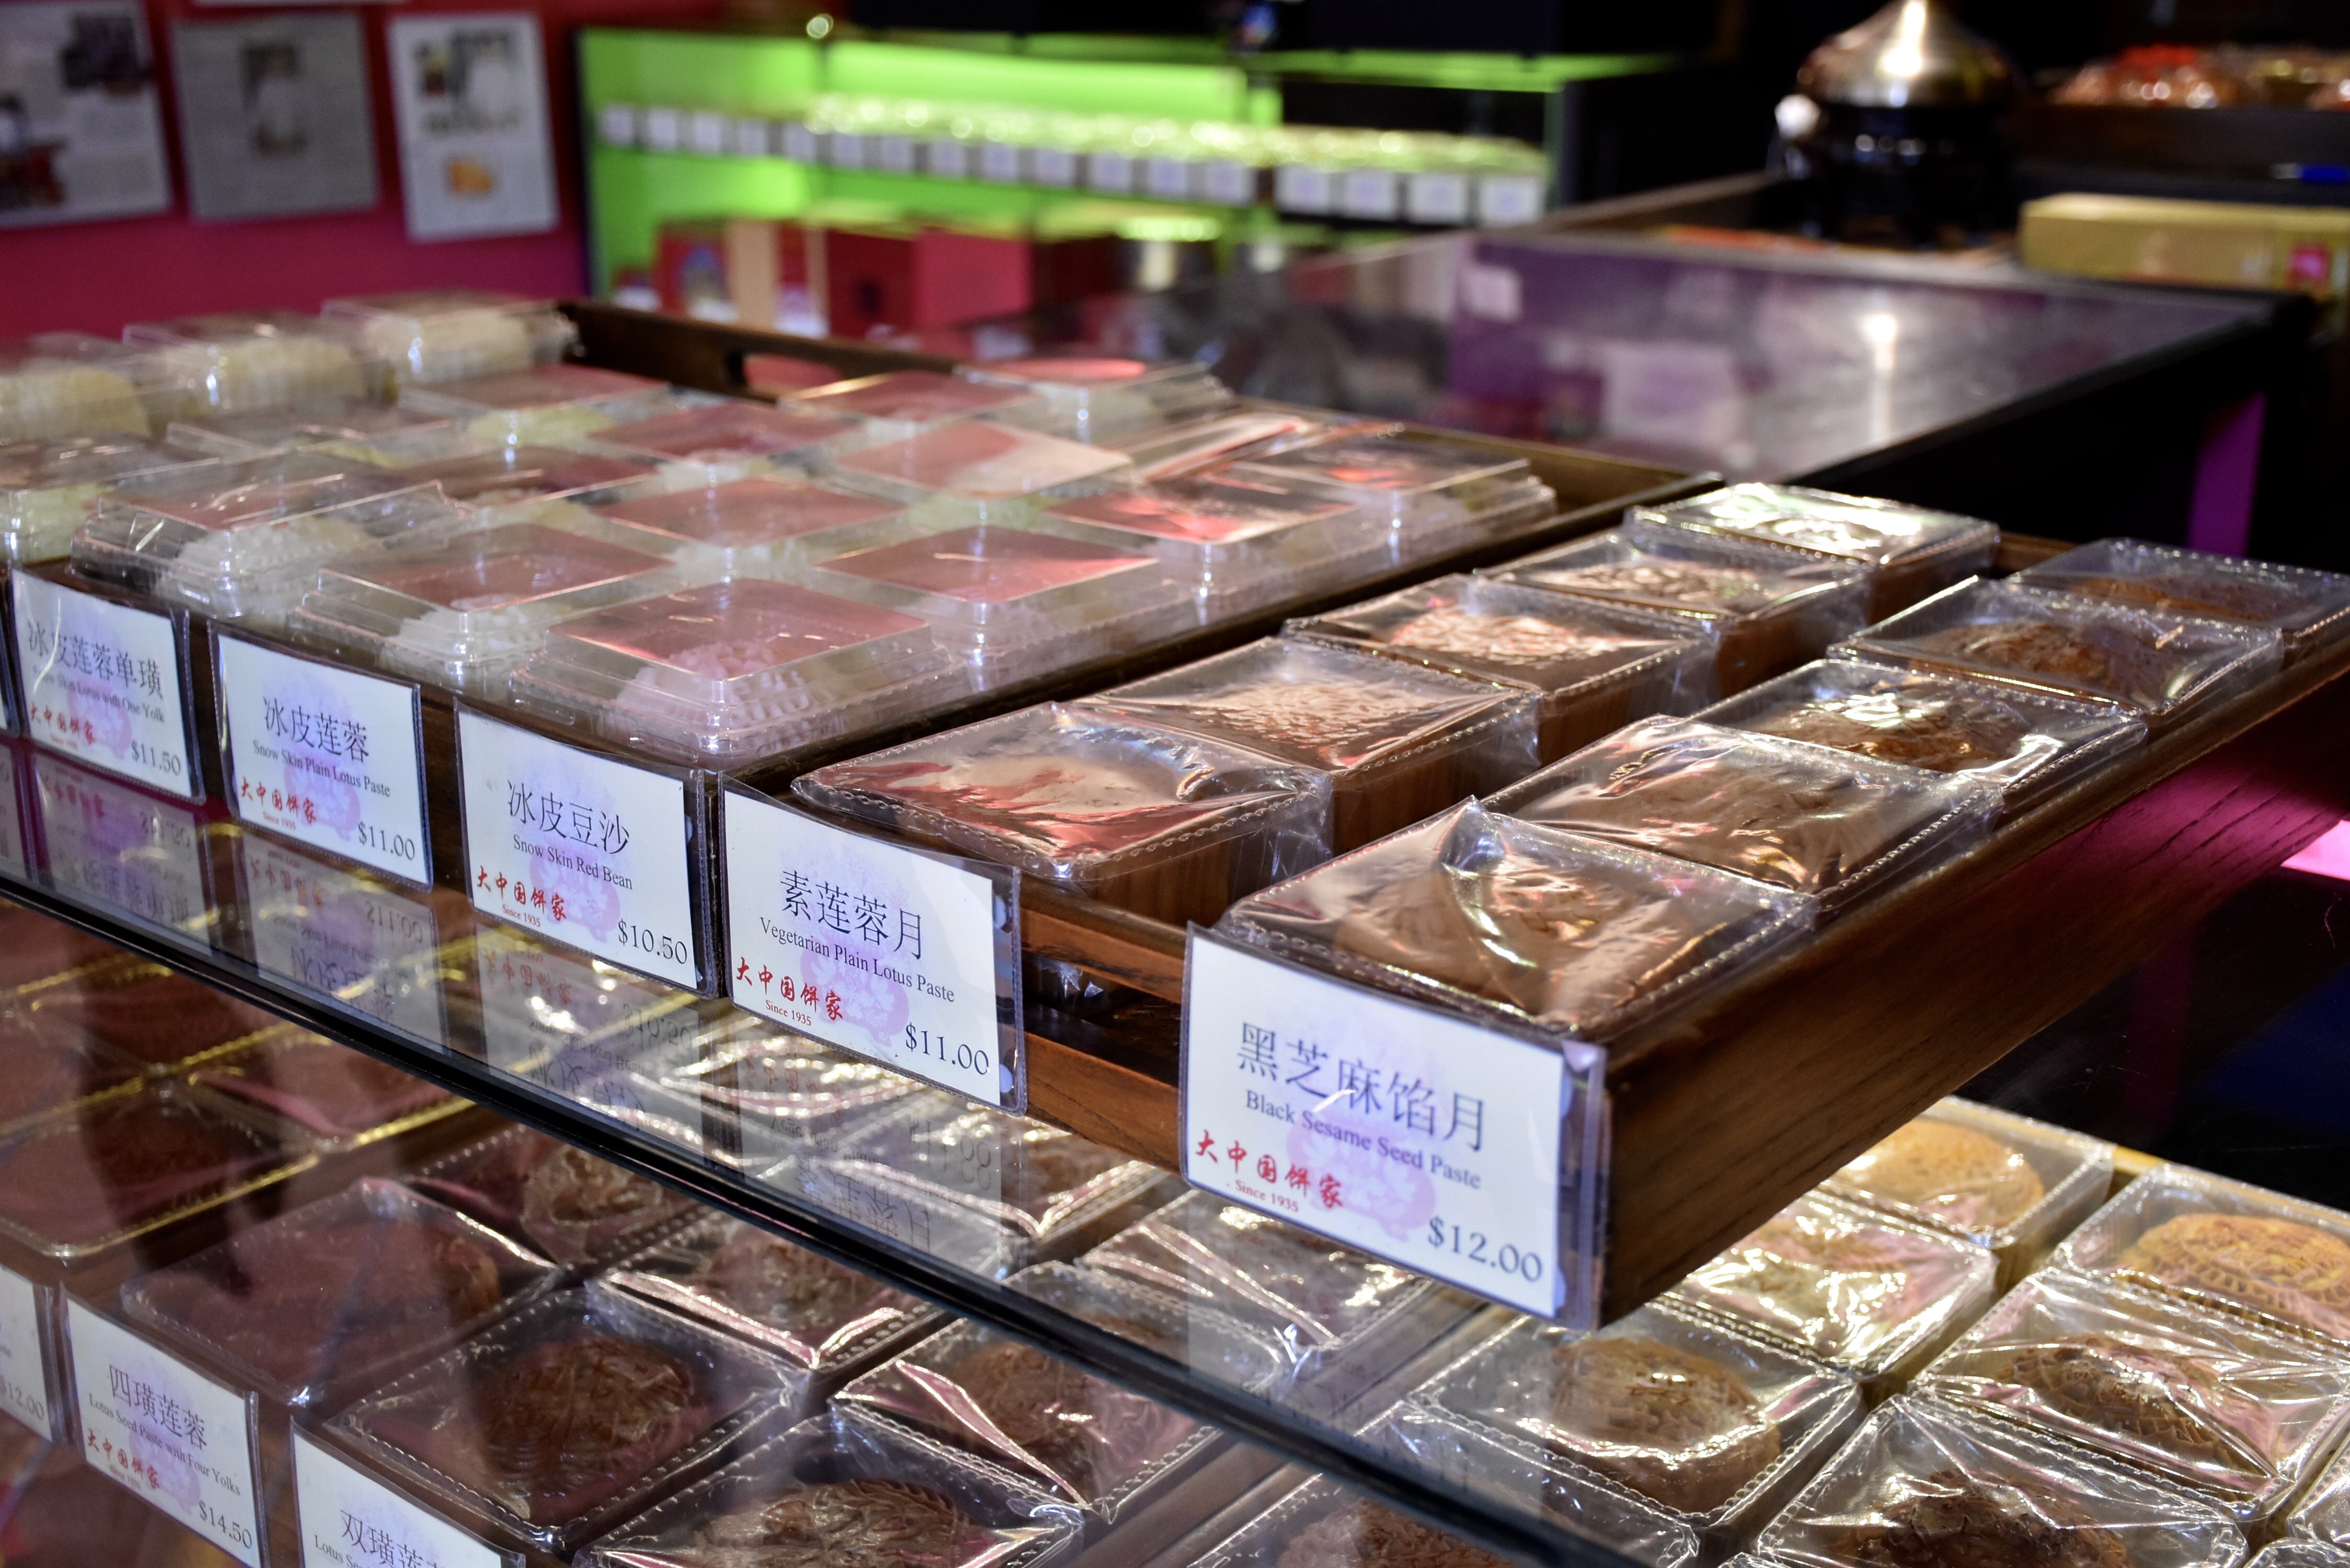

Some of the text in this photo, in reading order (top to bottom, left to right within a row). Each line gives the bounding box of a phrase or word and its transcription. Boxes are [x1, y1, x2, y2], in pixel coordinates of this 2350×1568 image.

[122, 696, 140, 716] One
[143, 704, 165, 723] Yolk
[263, 696, 369, 764] 冰皮莲蓉
[132, 739, 181, 777] $11.50
[253, 740, 390, 798] Snow Skin Plain Lotus Paste
[241, 777, 317, 824] 大中国饼家
[262, 811, 280, 826] Since
[508, 779, 630, 855] 冰皮豆沙
[358, 821, 416, 861] $11.00
[513, 835, 633, 890] Snow Skin Red Bean
[477, 865, 567, 922] 大中国饼家
[502, 904, 541, 928] Since 1935
[780, 869, 922, 961] 素莲蓉月
[617, 918, 688, 965] $10.50
[760, 916, 955, 1003] Vegetarian Plain Lotus Paste
[736, 956, 843, 1021] 大中国饼家
[765, 999, 812, 1027] Since 1935
[905, 1021, 989, 1076] $11.00
[1237, 1020, 1484, 1153] 黑芝麻馅月
[1246, 1089, 1481, 1190] Black Sesame Seed Paste
[1195, 1129, 1344, 1210] 大中国饼家
[1235, 1179, 1299, 1214] Since 1935
[1427, 1215, 1543, 1283] $12.00
[109, 1364, 207, 1451] 四璜莲蓉
[88, 1428, 160, 1489] 大中国饼家
[89, 1393, 241, 1496] Lotus Seed Paste with Four Yolks
[199, 1499, 252, 1550] $14.50
[315, 1535, 343, 1564] Lotus
[340, 1509, 444, 1568] 双璜莲
